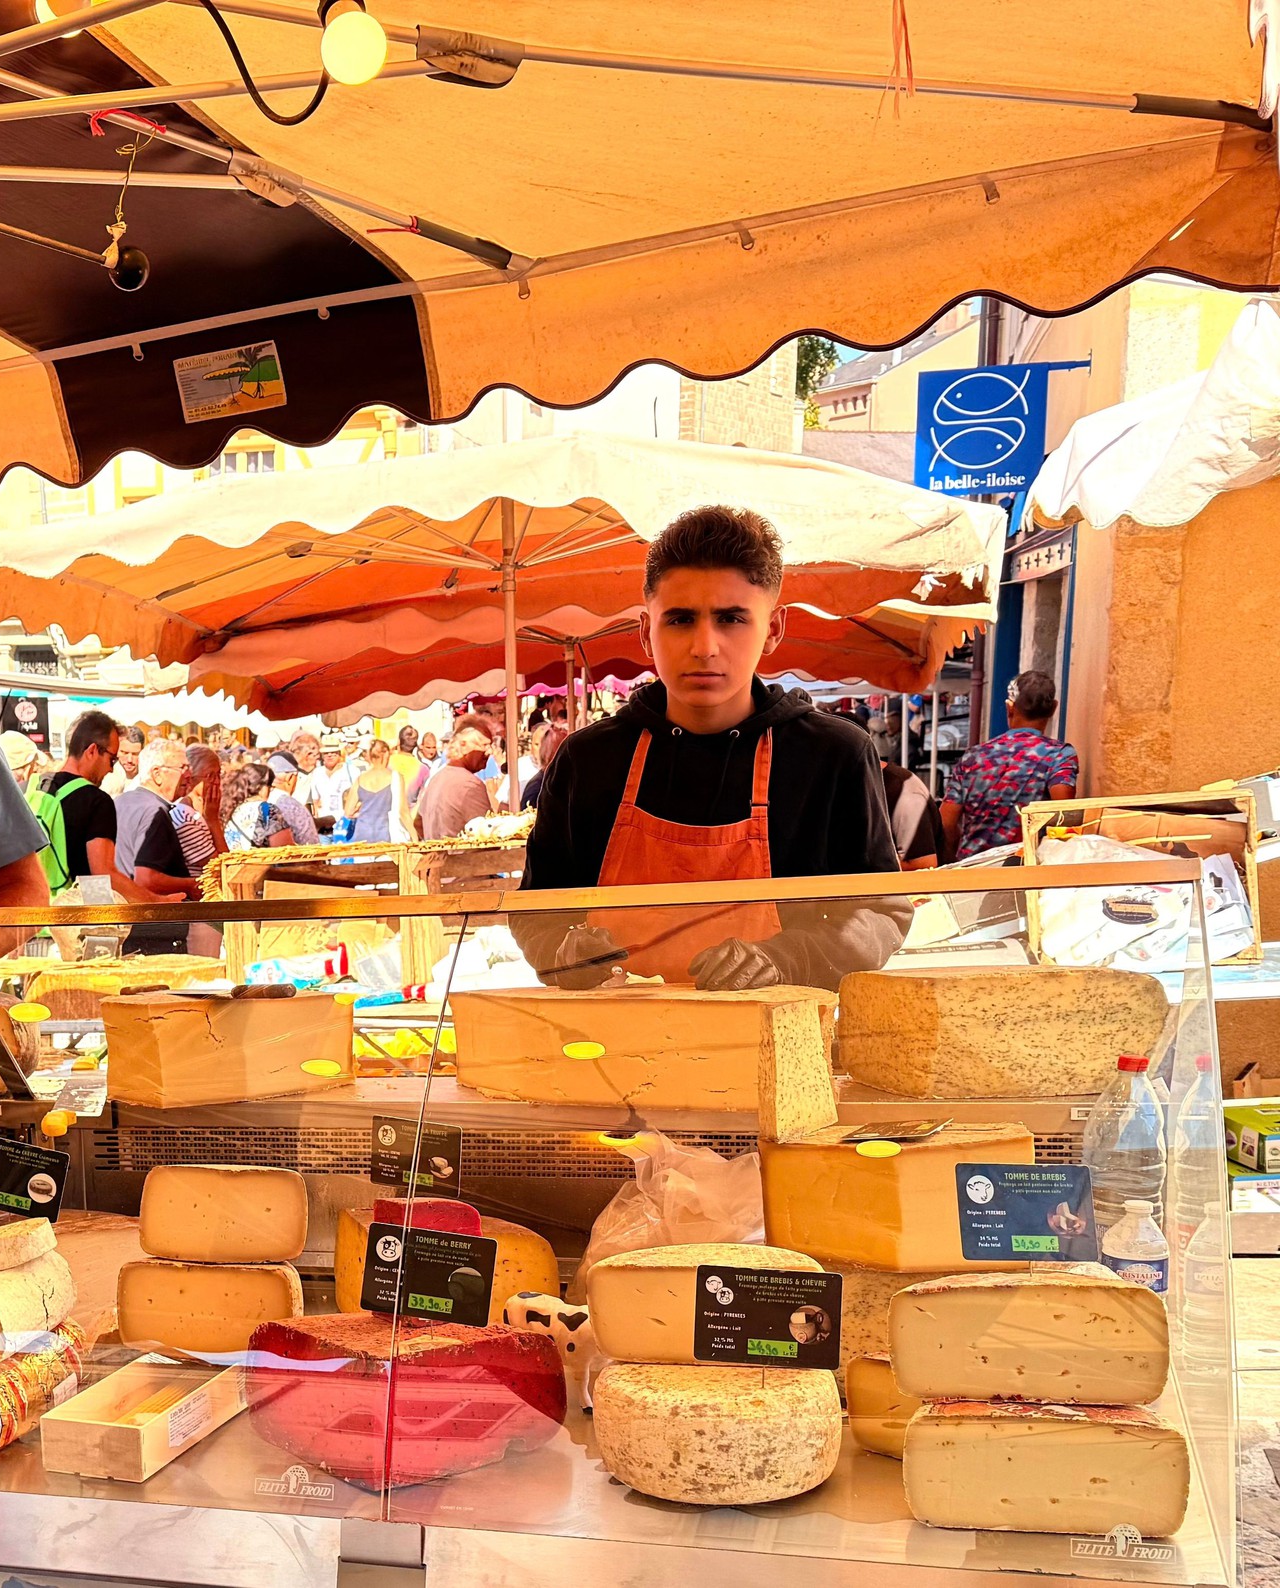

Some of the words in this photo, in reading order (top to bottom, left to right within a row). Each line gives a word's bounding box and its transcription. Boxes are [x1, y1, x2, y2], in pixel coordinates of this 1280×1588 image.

[929, 476, 943, 491] la
[945, 472, 1026, 490] belle-iloise
[1004, 1172, 1029, 1181] TOMME
[1031, 1173, 1040, 1181] DE
[1042, 1173, 1067, 1181] BREBIS
[415, 1235, 439, 1245] TOMME
[439, 1239, 449, 1248] de
[450, 1240, 472, 1250] BERRY
[735, 1274, 758, 1283] TOMME
[770, 1277, 793, 1285] BREBIS
[1117, 1271, 1162, 1280] CRISTALINE
[258, 1481, 288, 1493] ELITE
[299, 1485, 331, 1497] FROID
[1074, 1543, 1114, 1556] ELITE
[1131, 1546, 1172, 1560] FROID
